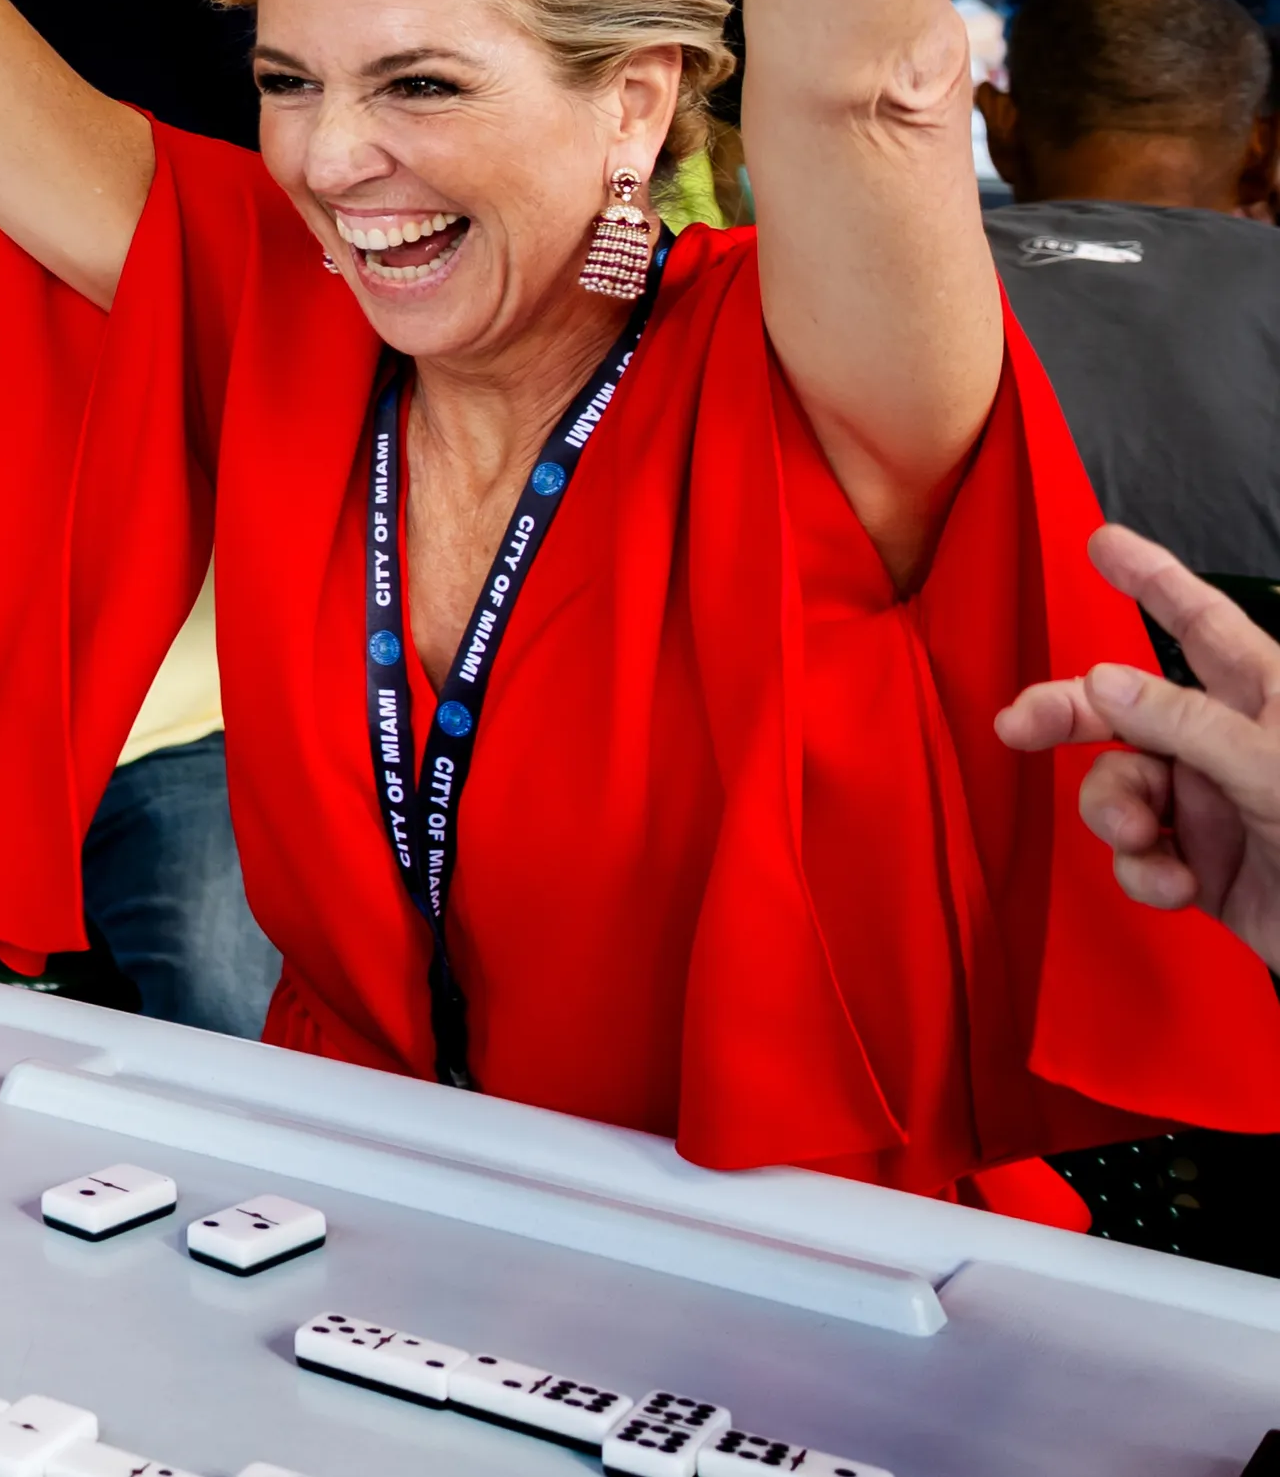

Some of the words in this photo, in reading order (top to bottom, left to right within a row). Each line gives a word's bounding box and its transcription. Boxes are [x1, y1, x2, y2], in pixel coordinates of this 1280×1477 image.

[564, 382, 616, 448] MIAMI
[375, 433, 389, 504] MIAMI
[374, 511, 389, 543] OF
[504, 514, 535, 572] CITY
[374, 549, 392, 607] CITY
[489, 574, 510, 608] OF
[458, 609, 497, 683] MIAMI
[378, 689, 401, 764] MIAMI
[385, 770, 404, 803] OF
[430, 756, 454, 808] CITY
[390, 809, 411, 868] CITY
[428, 812, 446, 841] OF
